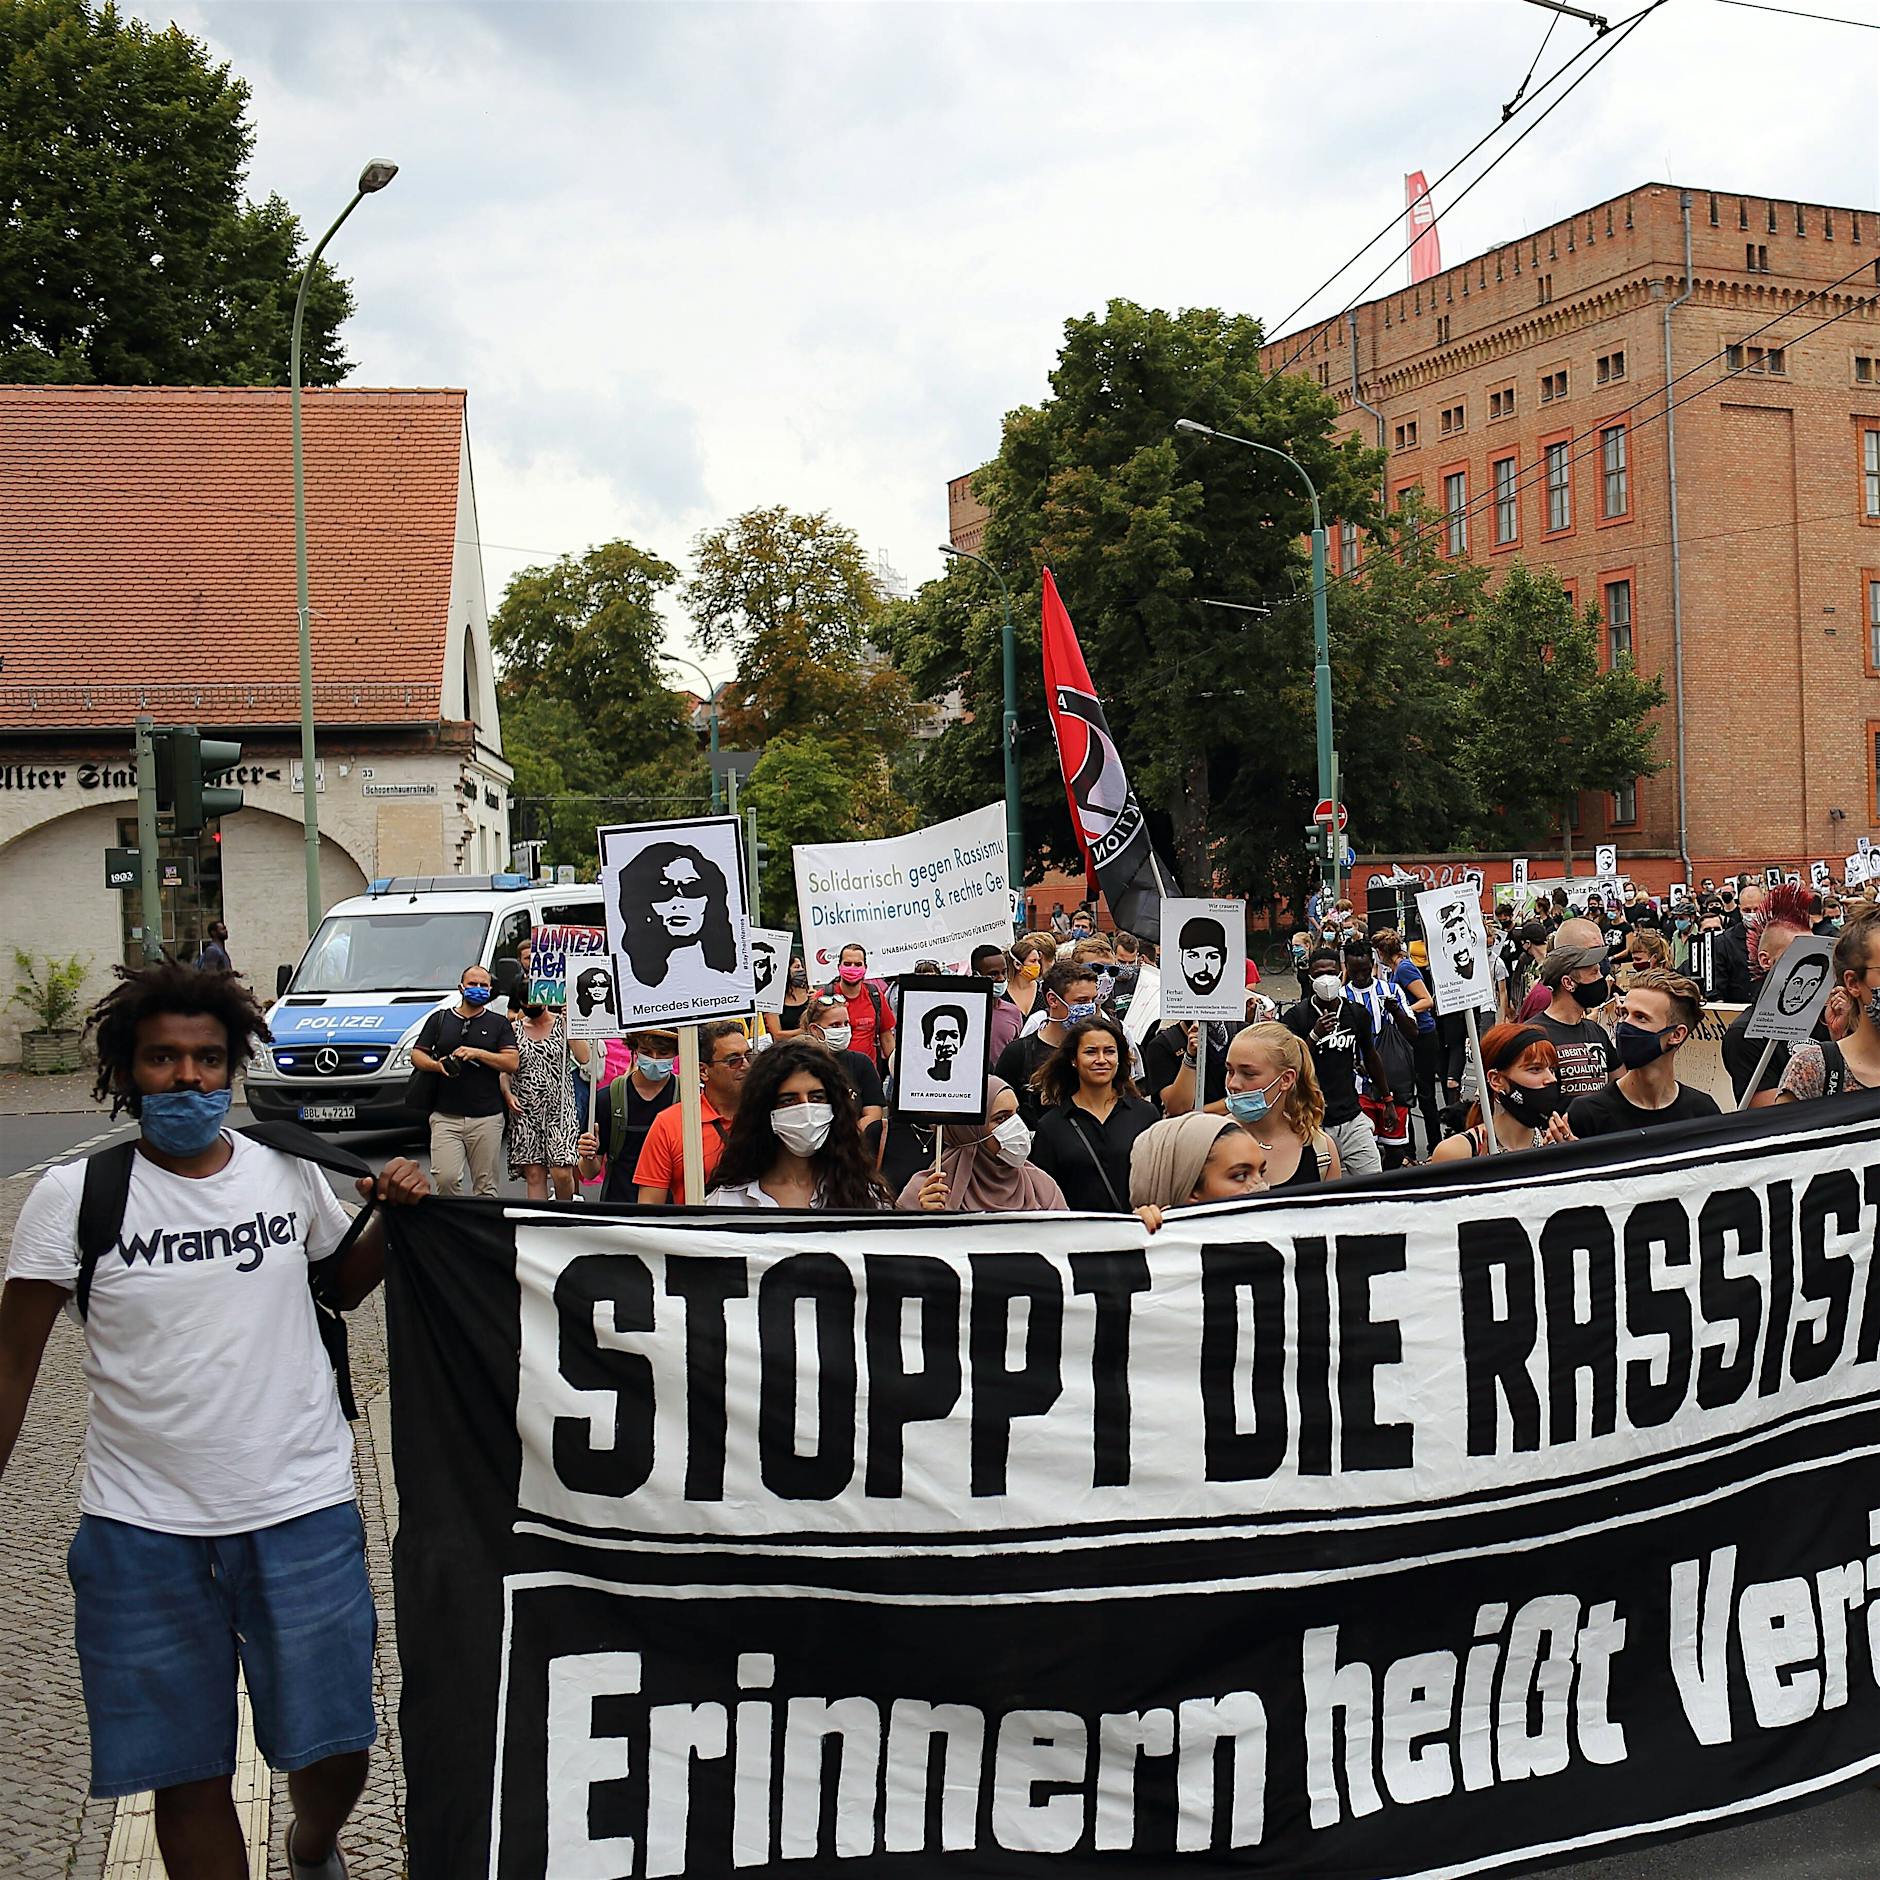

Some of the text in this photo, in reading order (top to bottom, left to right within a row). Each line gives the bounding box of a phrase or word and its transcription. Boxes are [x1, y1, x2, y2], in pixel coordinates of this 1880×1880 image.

[808, 864, 903, 893] Solidarisch
[909, 856, 952, 887] gegen
[812, 897, 931, 926] Diskriminierung
[935, 888, 945, 909] &
[949, 878, 983, 904] rechte
[881, 941, 928, 955] UNABHÄNGIGE
[928, 929, 973, 947] UNTERSTÜTZUNG
[295, 1015, 385, 1030] POLIZEI
[632, 999, 689, 1015] Mercedes
[692, 995, 740, 1009] Kierpacz
[117, 1211, 297, 1273] Wrangler
[552, 1248, 1151, 1502] STOPPT
[1201, 1233, 1415, 1482] DIE
[546, 1652, 1267, 1880] Erinnern
[1303, 1594, 1627, 1829] heißt
